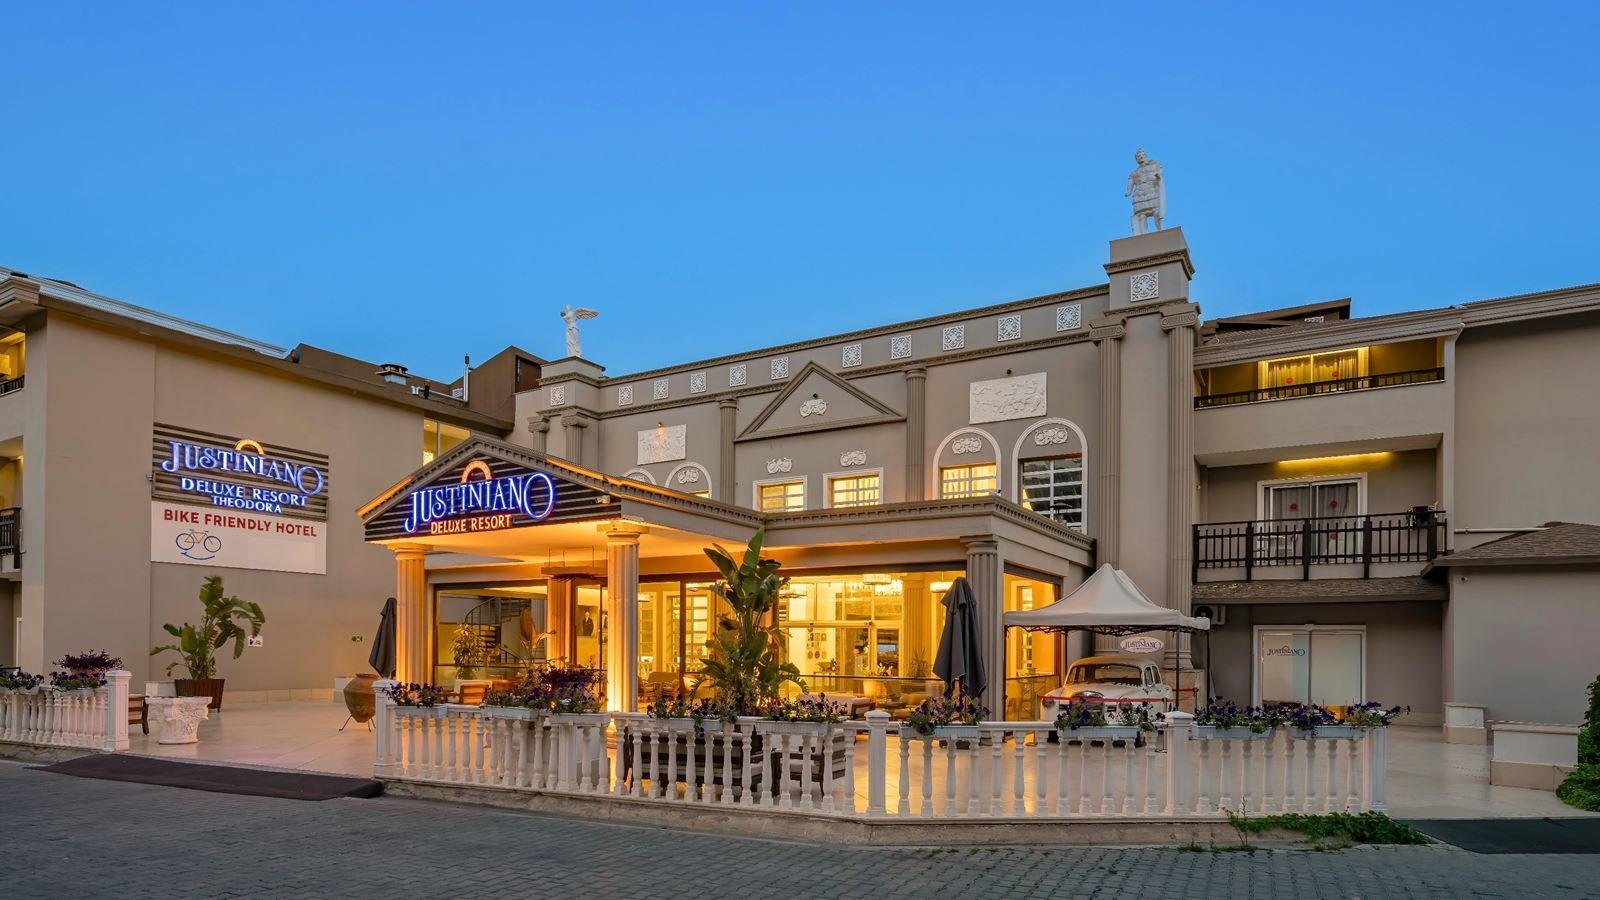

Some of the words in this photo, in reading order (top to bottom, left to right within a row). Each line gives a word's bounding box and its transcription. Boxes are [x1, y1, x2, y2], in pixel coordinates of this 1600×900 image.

[161, 440, 324, 495] JUSTINIANO
[180, 477, 245, 498] DELUXE
[252, 488, 308, 507] RESORT
[212, 495, 282, 514] THEODORA
[405, 473, 554, 533] JUSTINIANO
[164, 508, 200, 524] BIKE
[204, 513, 271, 532] FRIENDLY
[276, 522, 317, 537] HOTEL
[431, 519, 467, 534] DELUXE
[471, 514, 512, 530] RESORT
